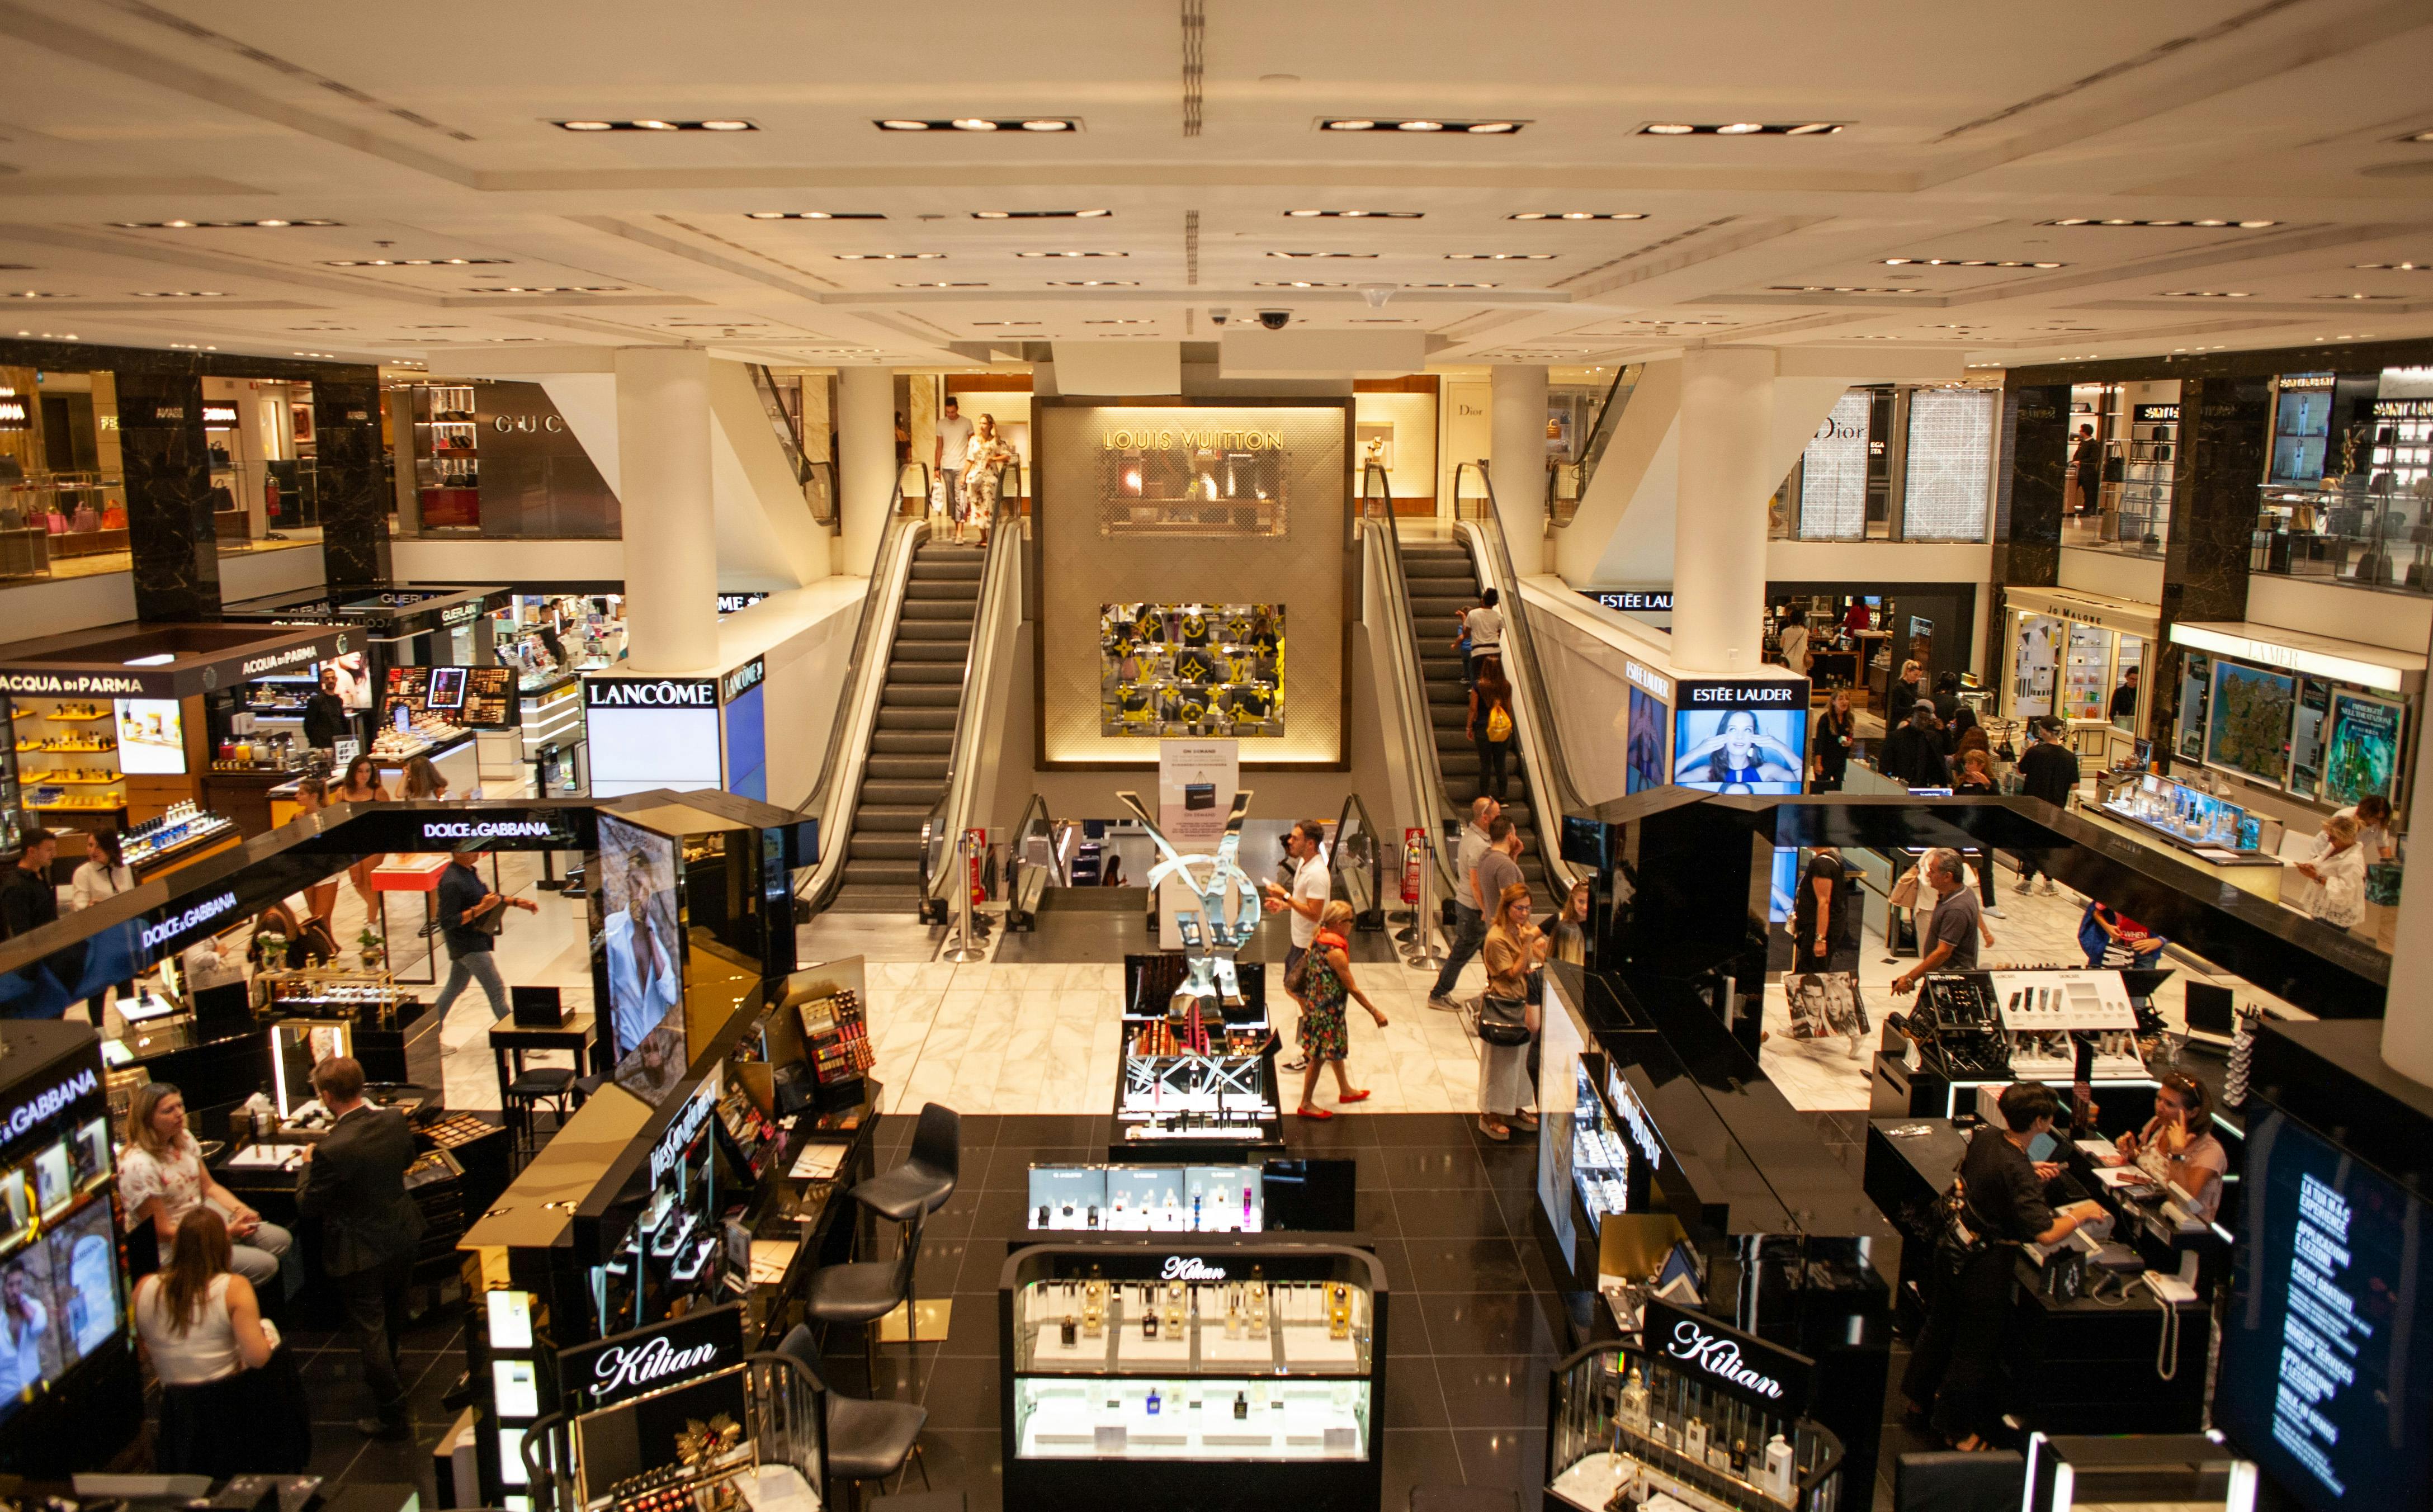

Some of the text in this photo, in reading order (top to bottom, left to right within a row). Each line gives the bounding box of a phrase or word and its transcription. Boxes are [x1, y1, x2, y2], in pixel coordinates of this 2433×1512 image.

[1459, 404, 1483, 417] Dior
[1103, 430, 1284, 449] LOUIS VUITTON
[442, 603, 476, 621] GUERLAIN
[242, 656, 277, 675] ACQUA
[285, 645, 318, 663] PARMA
[0, 675, 144, 692] ACQUA DI PARMA
[589, 681, 714, 705] LANCÔME
[1736, 688, 1792, 701] LAUDER
[423, 821, 551, 838] DOLCE&GABBANA
[142, 892, 238, 949] DOLCE&GABBANA
[2297, 1219, 2351, 1268] APPLICAZIONI
[1160, 1255, 1225, 1281] Kilian
[2292, 1258, 2317, 1286] FOCUS
[590, 1336, 717, 1396] Kilian
[1667, 1320, 1783, 1399] Kilian
[2284, 1320, 2315, 1353] MAKEUP
[2315, 1344, 2354, 1385] SERVICES
[2281, 1344, 2335, 1398] APPLICATIONS
[2287, 1363, 2322, 1402] LESSONS
[2308, 1409, 2337, 1445] DEMOS
